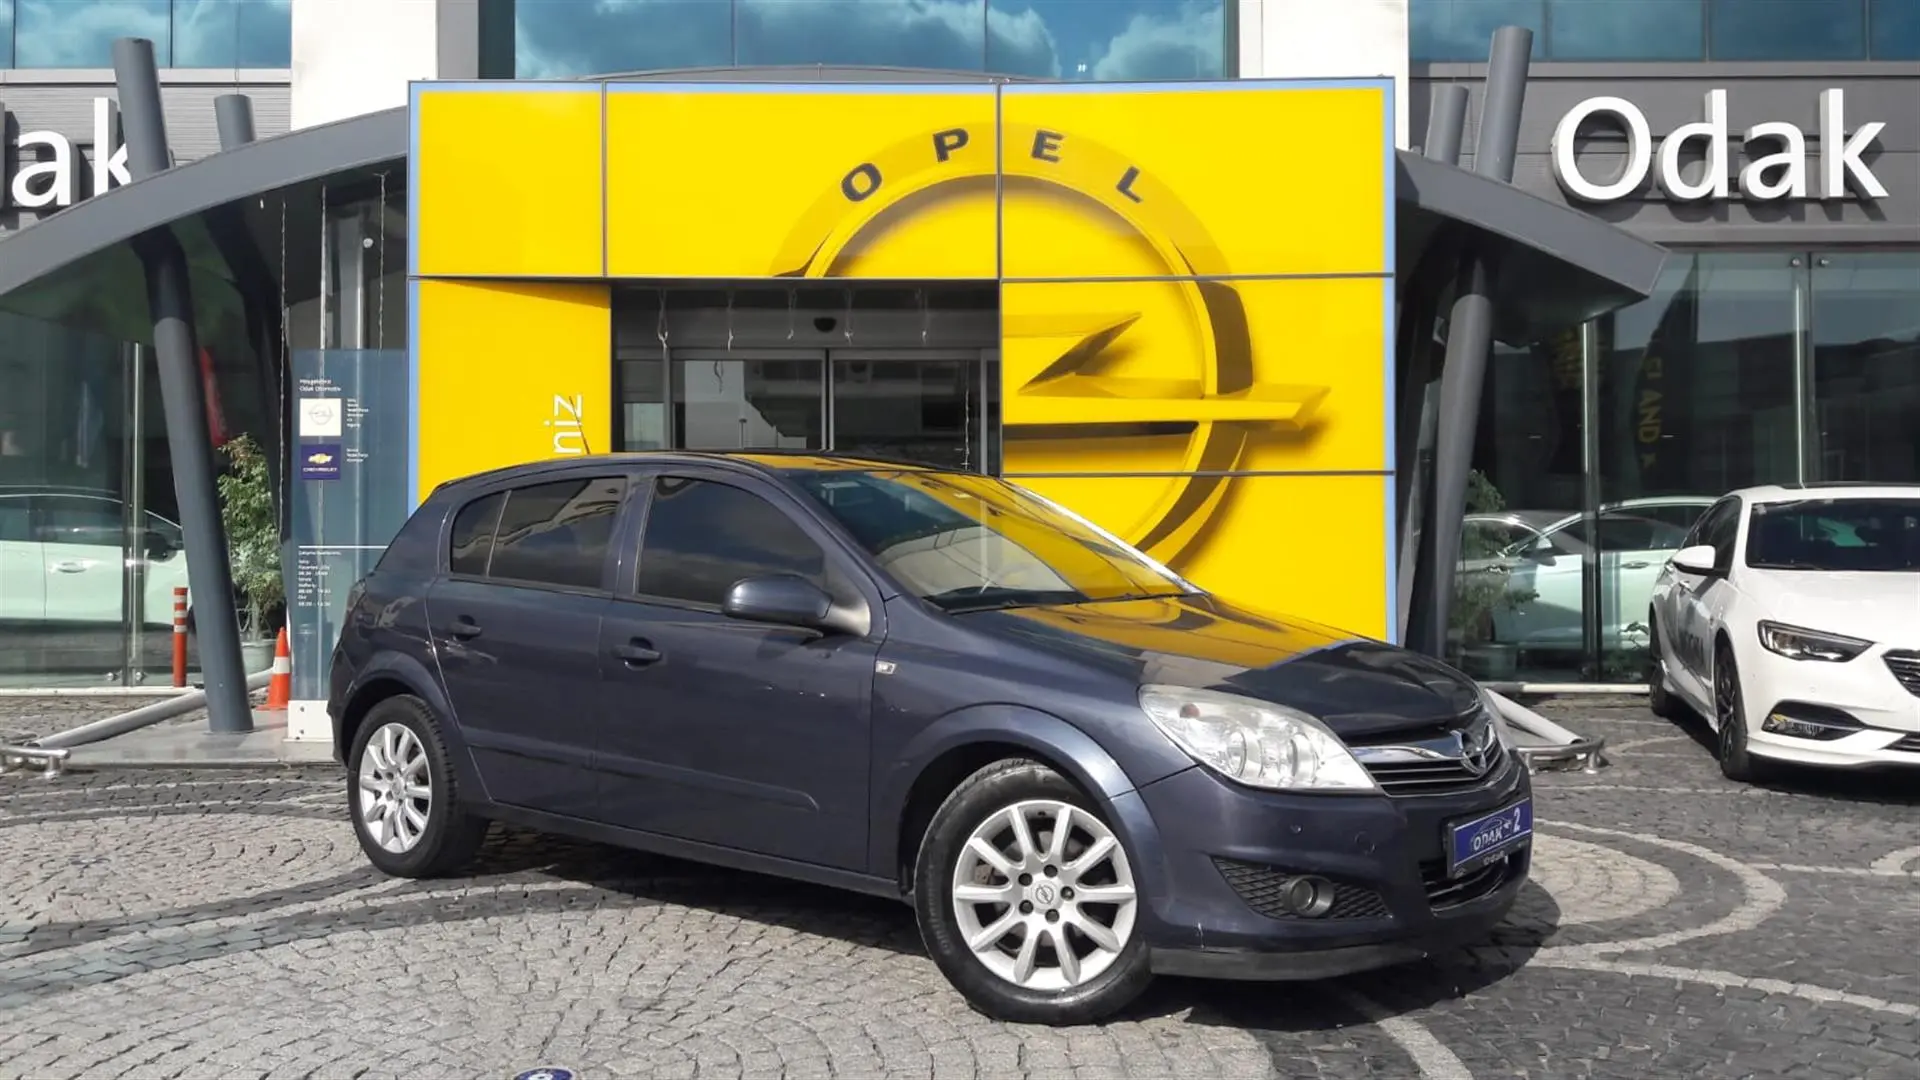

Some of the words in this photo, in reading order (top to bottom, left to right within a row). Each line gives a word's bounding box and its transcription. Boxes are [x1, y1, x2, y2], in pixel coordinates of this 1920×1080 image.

[10, 97, 132, 207] ak
[840, 127, 1143, 204] OPEL
[1551, 88, 1890, 200] Odak
